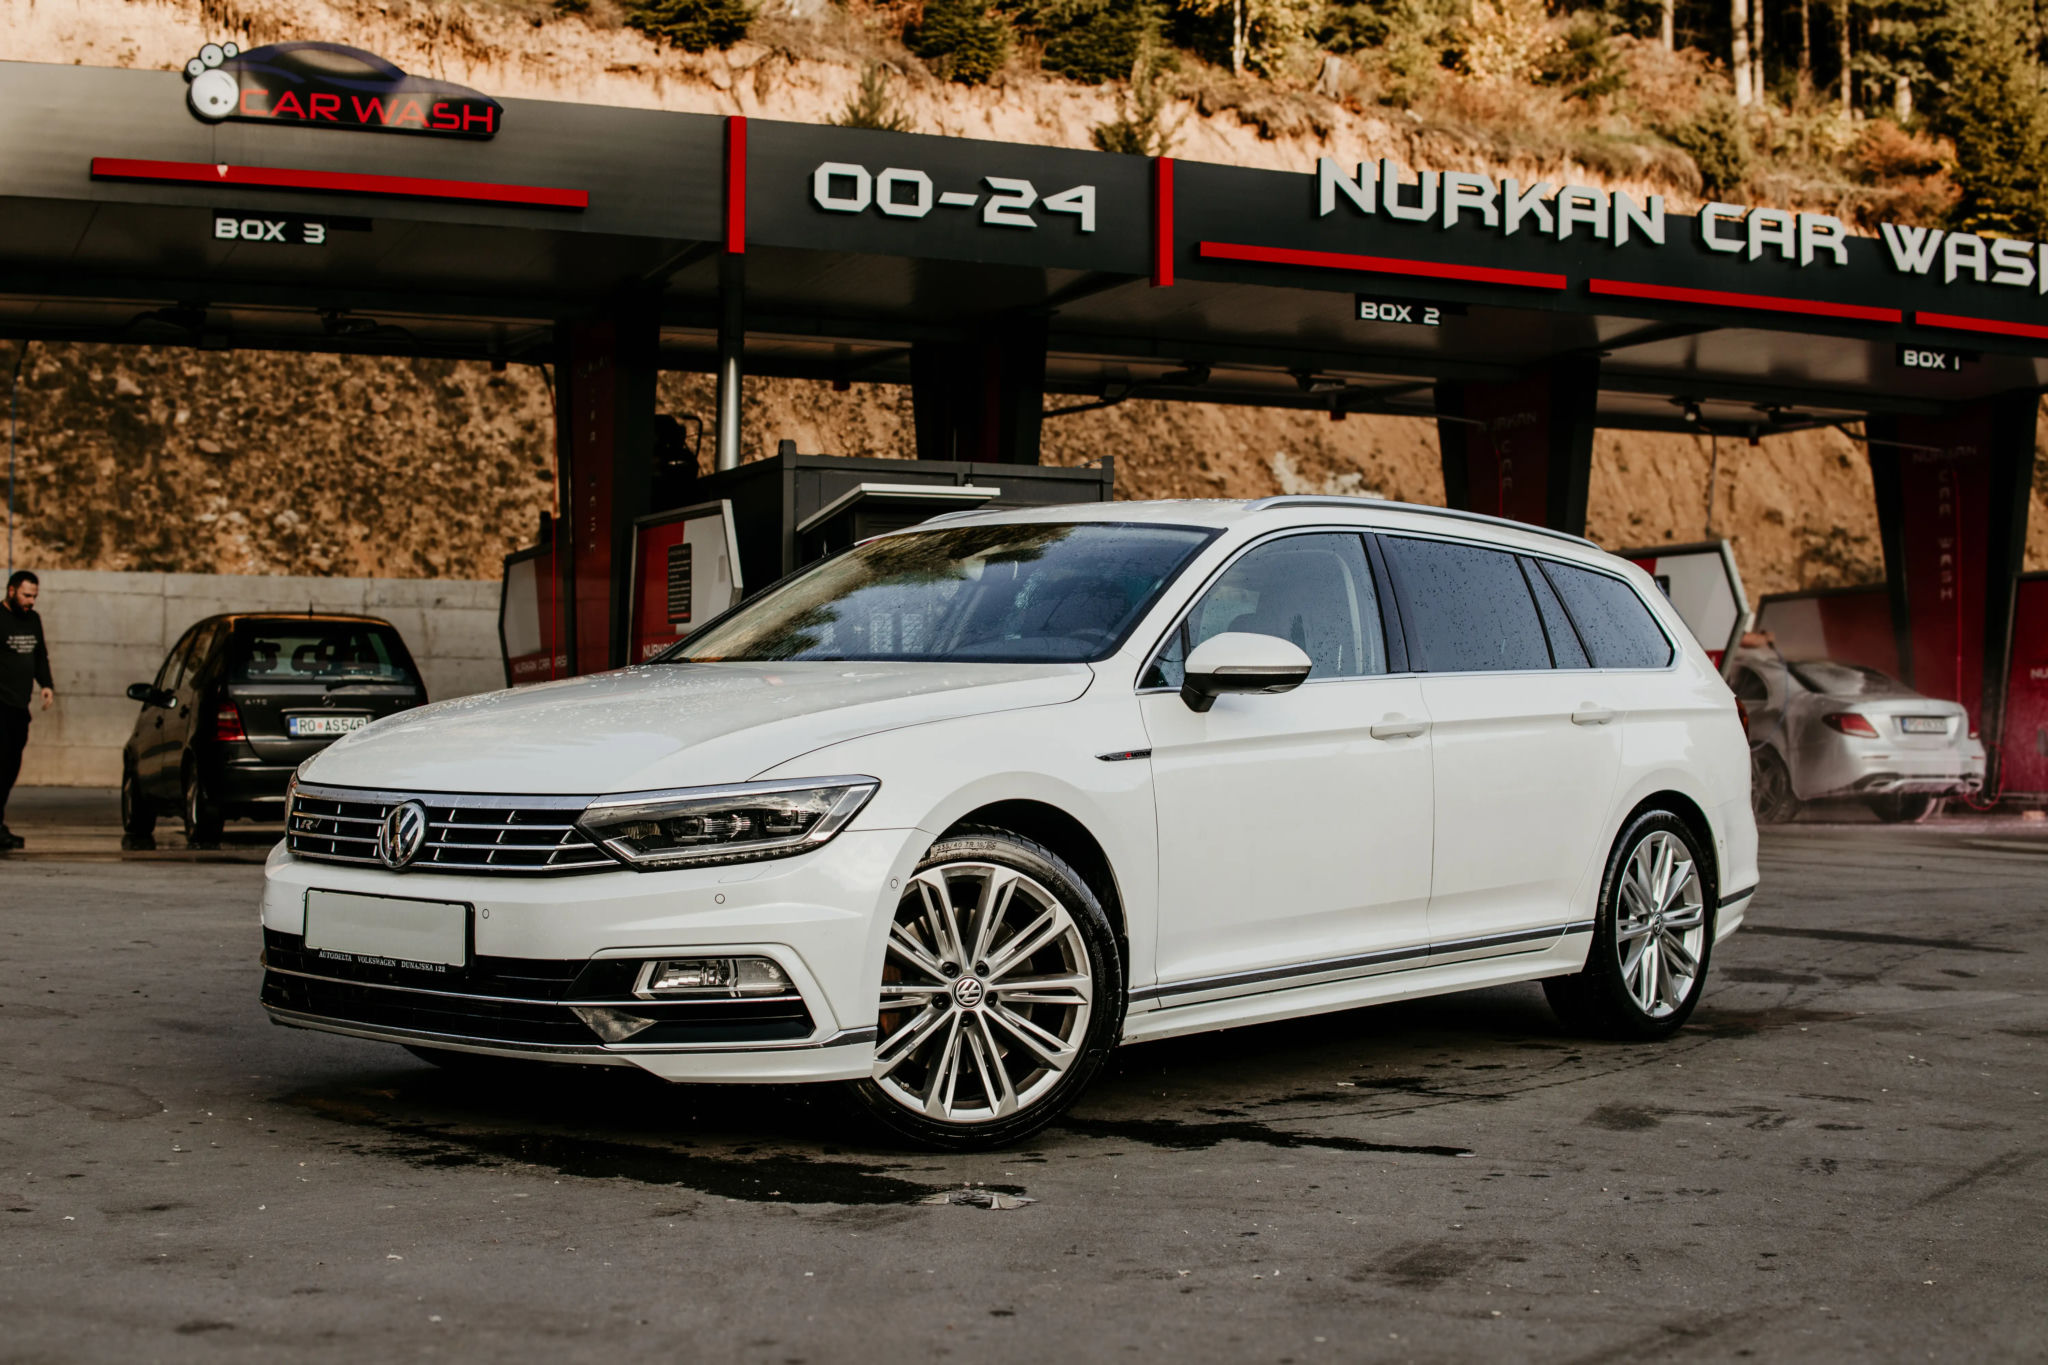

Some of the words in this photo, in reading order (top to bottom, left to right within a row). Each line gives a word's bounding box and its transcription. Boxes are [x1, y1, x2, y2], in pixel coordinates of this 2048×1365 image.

[240, 88, 341, 121] CAR
[351, 95, 494, 133] WASH
[814, 161, 1096, 232] 00-24
[215, 217, 286, 242] BOX
[303, 222, 326, 244] 3
[1317, 157, 1665, 248] NURKAN
[1701, 202, 1848, 267] CAR
[1880, 222, 2048, 295] WAS
[1360, 301, 1412, 323] BOX
[1424, 307, 1440, 325] 2
[1903, 350, 1945, 369] BOX
[299, 719, 316, 732] RO
[318, 950, 352, 962] AUTODELTA
[357, 955, 397, 968] VOLKSWAGEN
